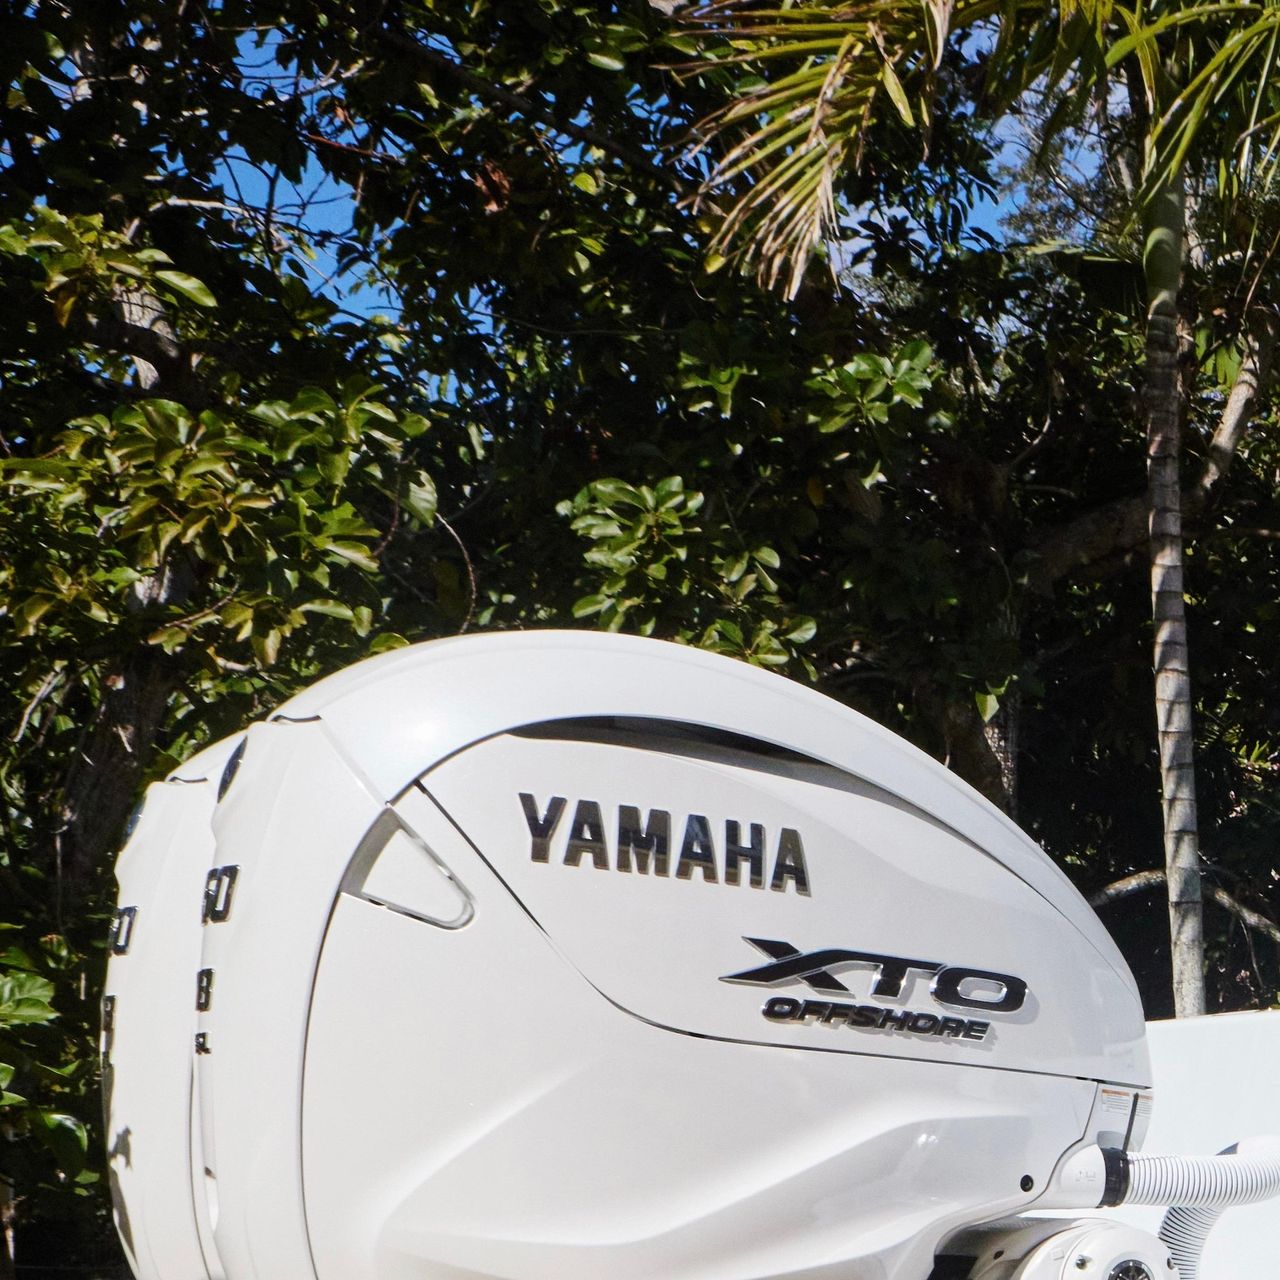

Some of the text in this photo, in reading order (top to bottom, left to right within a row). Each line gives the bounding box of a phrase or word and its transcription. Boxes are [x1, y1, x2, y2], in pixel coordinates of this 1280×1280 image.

[518, 792, 812, 897] YAMAHA
[719, 936, 1029, 1013] XTO
[761, 995, 991, 1042] OFFSHORE
